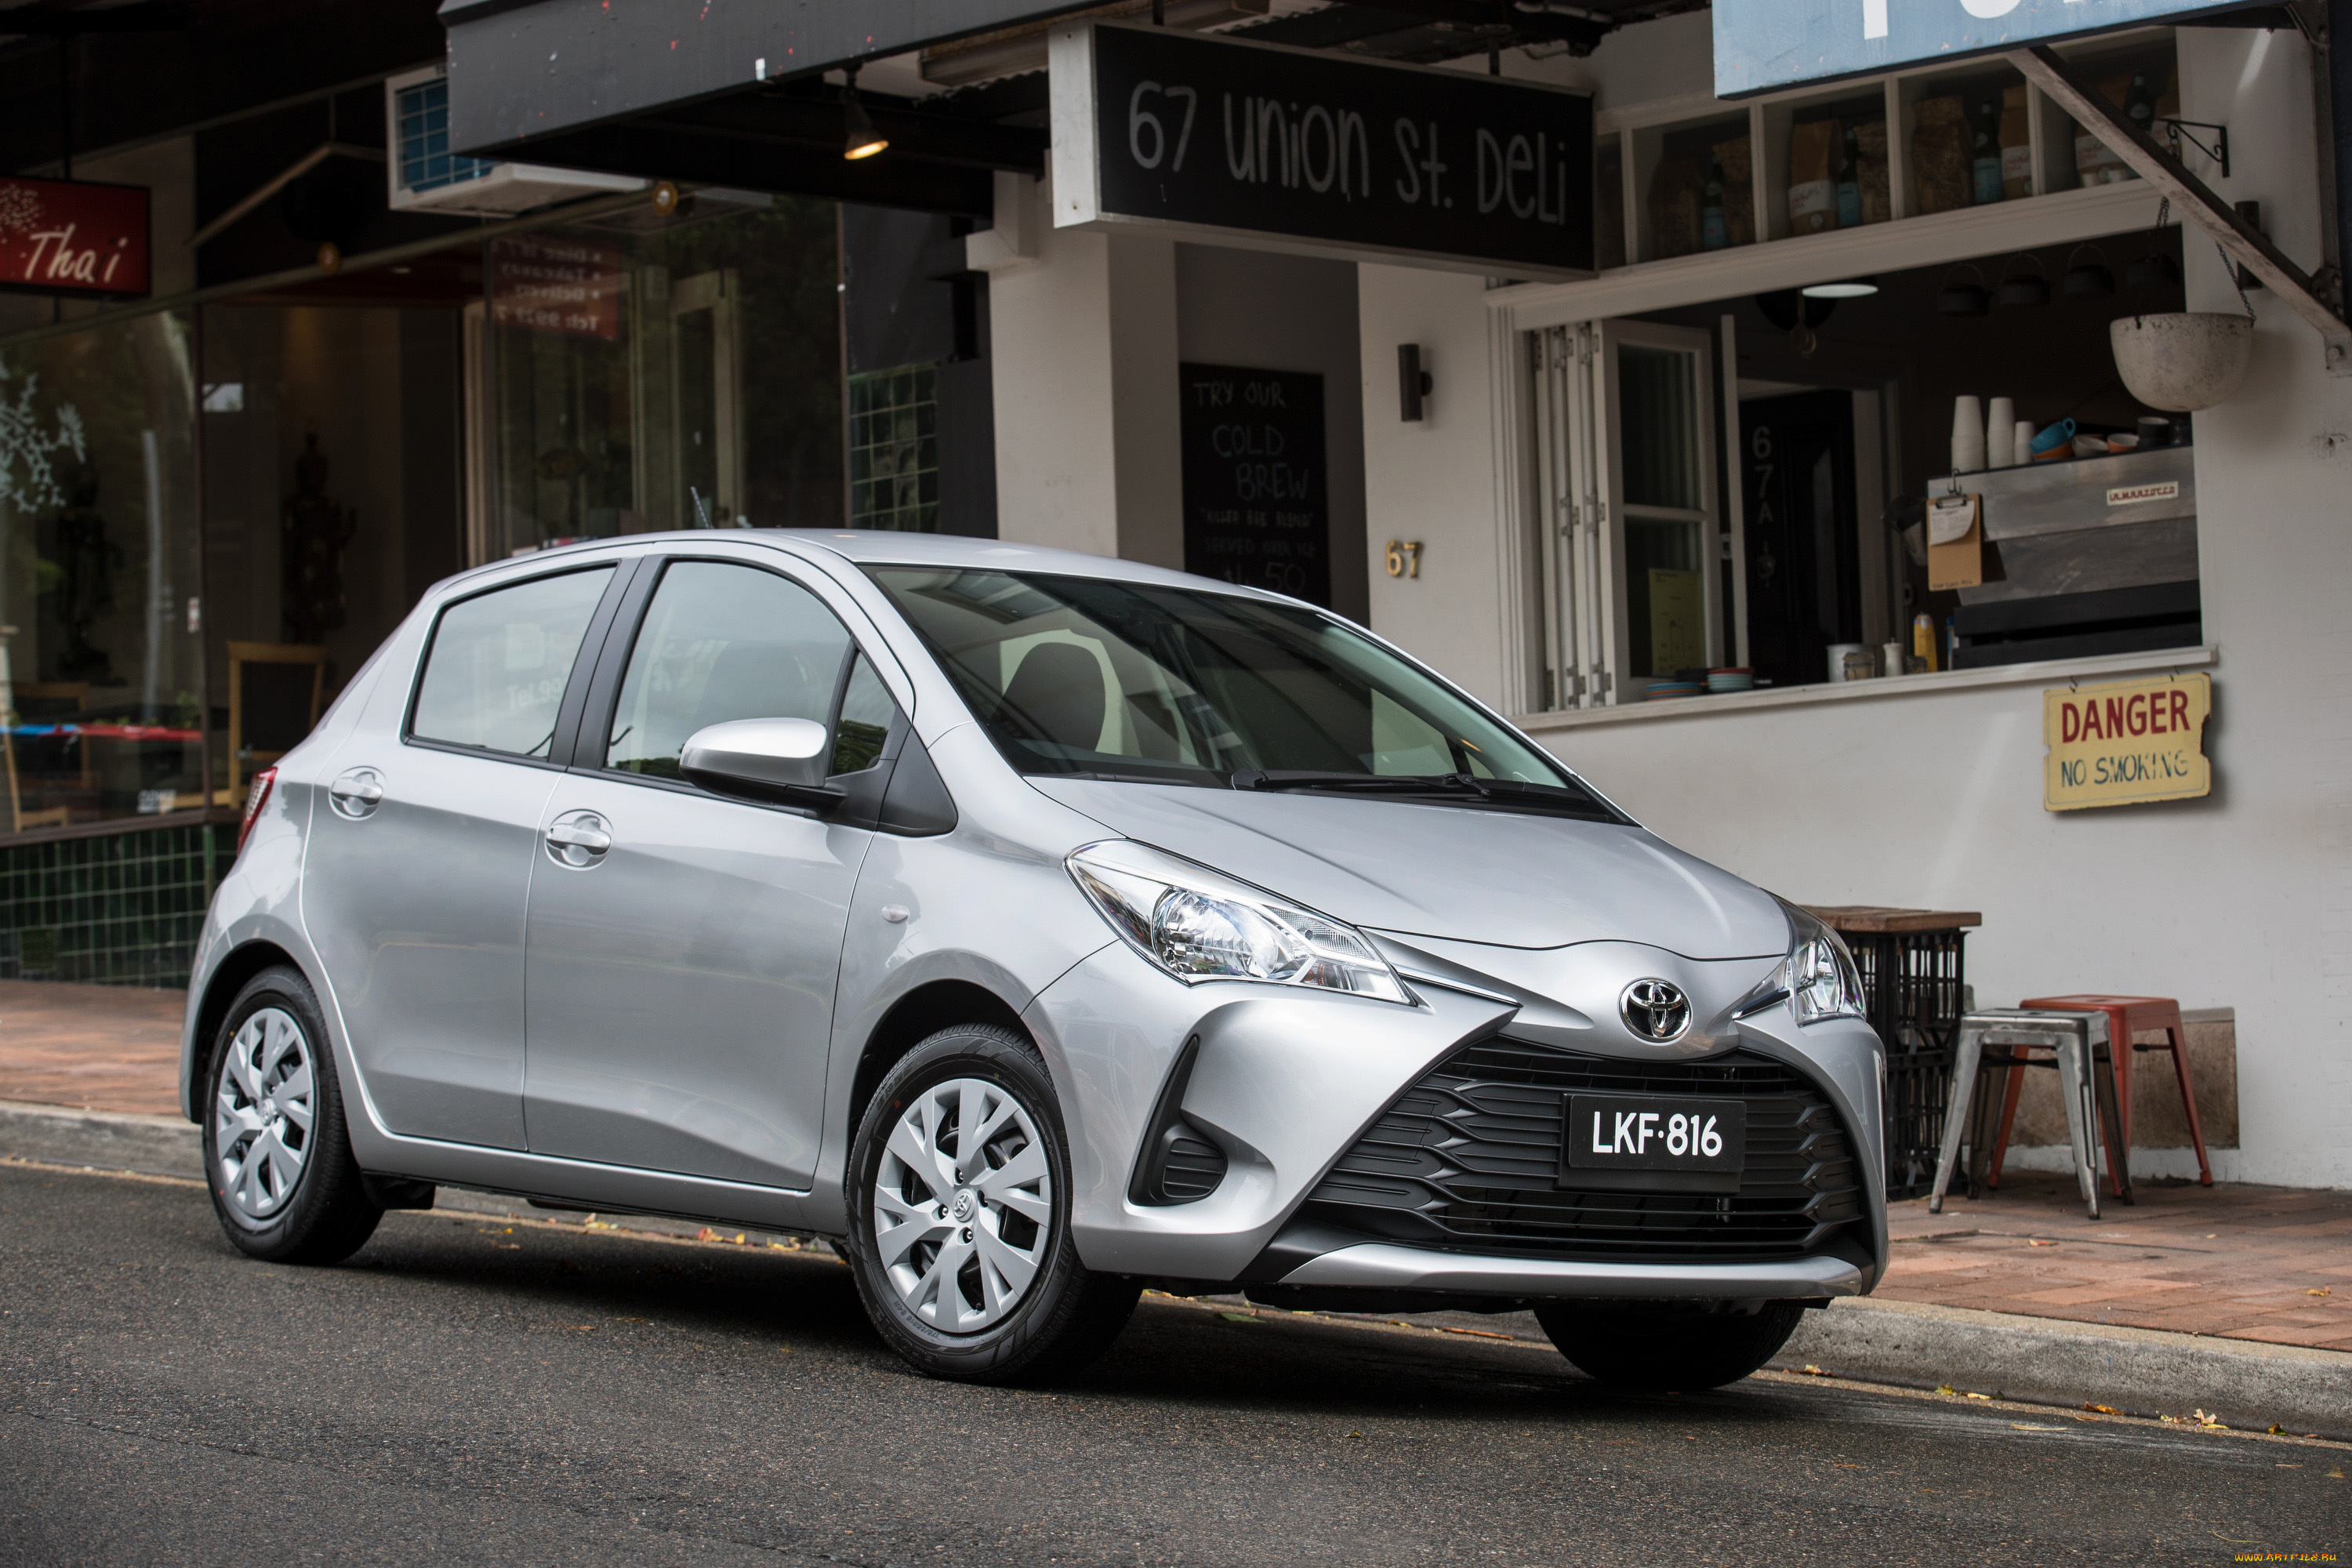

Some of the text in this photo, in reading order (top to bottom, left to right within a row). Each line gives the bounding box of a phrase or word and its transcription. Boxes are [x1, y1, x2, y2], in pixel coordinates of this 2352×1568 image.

[1128, 81, 1196, 172] 67
[1394, 118, 1453, 209] St.
[24, 222, 129, 284] Thai
[1192, 379, 1287, 408] TRY OUR
[1212, 423, 1285, 458] COLD
[1235, 463, 1310, 501] BREW
[1385, 539, 1424, 579] 67
[2061, 690, 2190, 743] DANGER
[2061, 750, 2189, 789] NO SMOKING
